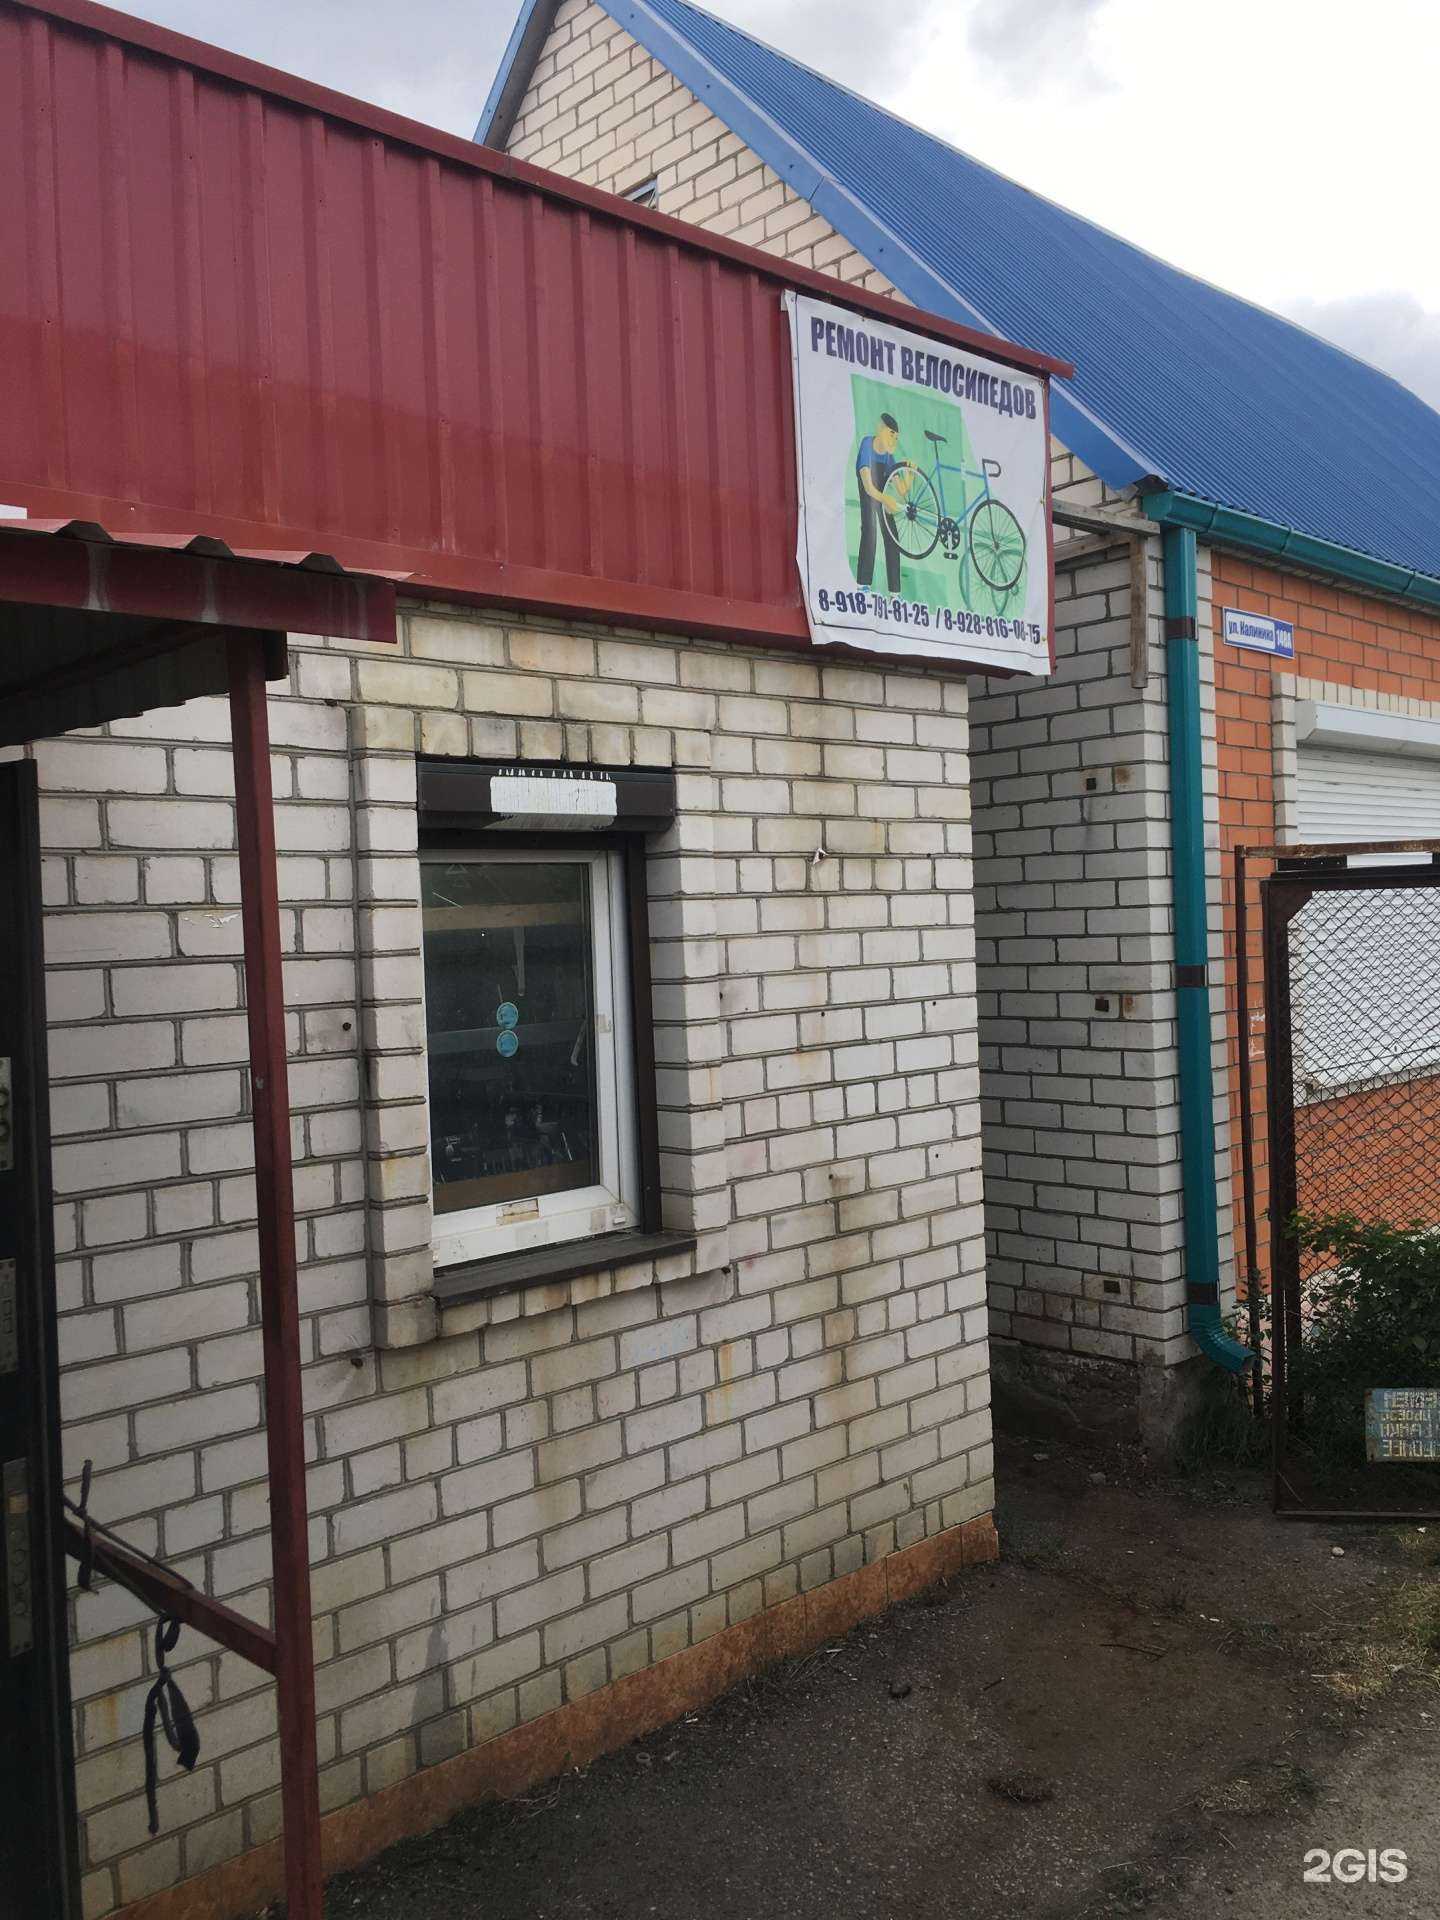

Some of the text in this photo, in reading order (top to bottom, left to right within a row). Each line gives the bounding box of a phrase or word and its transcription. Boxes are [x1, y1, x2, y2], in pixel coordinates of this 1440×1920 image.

[810, 316, 1037, 420] РЕМОНТ ВЕЛОСИПЕДОВ
[1228, 620, 1239, 634] ул.
[1240, 621, 1274, 641] Калинина
